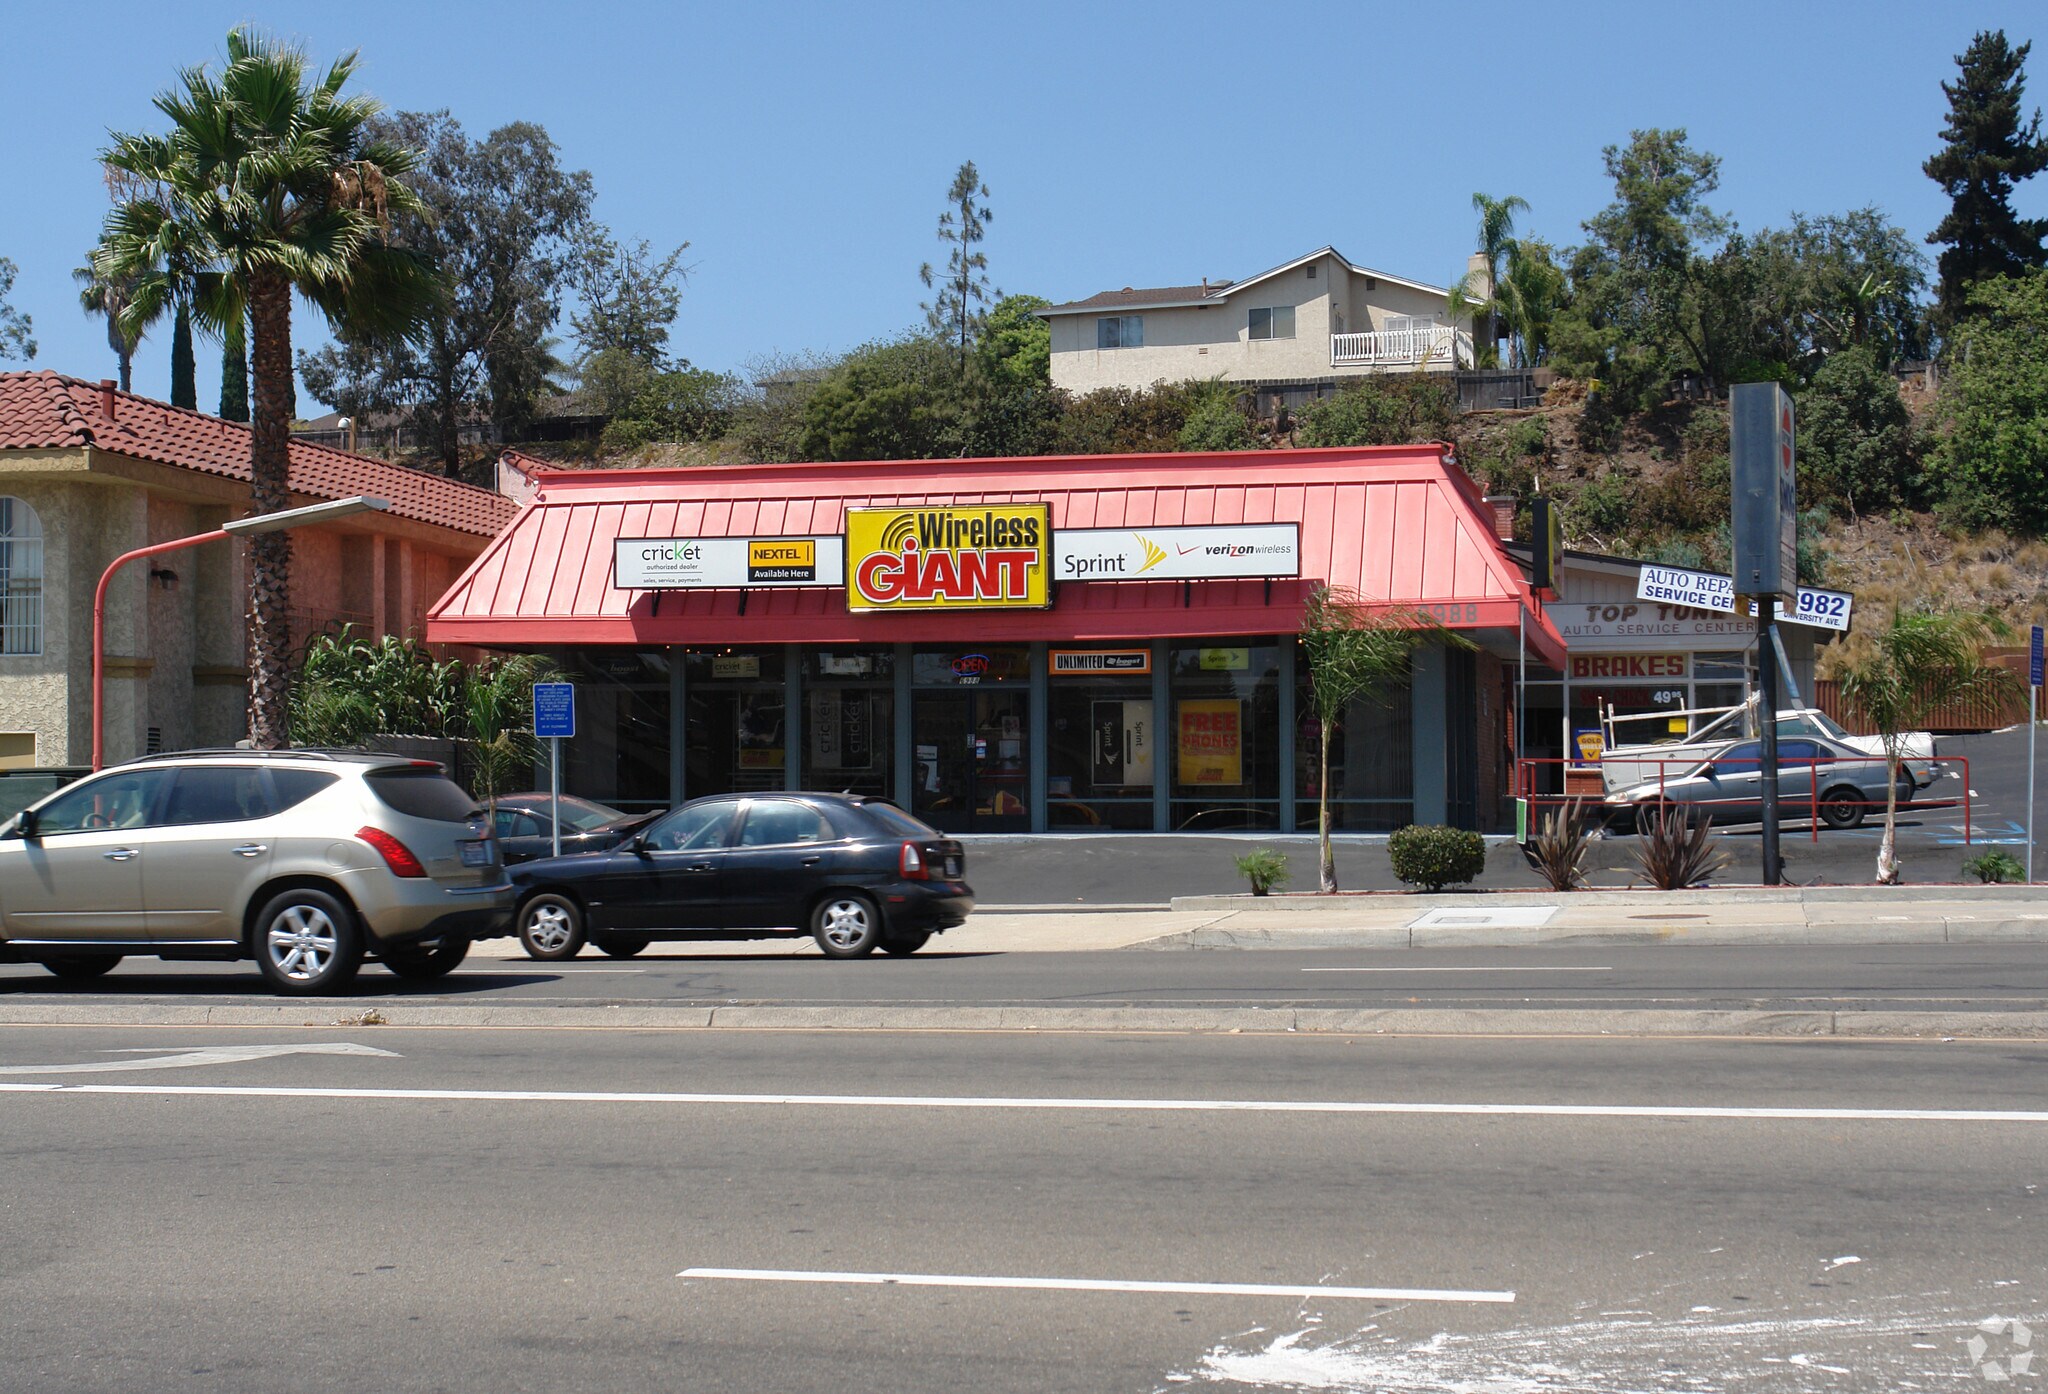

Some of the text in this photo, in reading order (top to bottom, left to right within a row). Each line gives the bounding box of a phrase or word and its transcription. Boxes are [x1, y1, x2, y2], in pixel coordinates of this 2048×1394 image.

[918, 511, 1038, 549] Wireless
[642, 541, 702, 561] cricket
[753, 548, 801, 560] NEXTEL
[646, 563, 678, 571] authorized
[754, 569, 809, 578] Available Here
[1065, 553, 1126, 577] Sprint
[658, 577, 677, 585] service,
[678, 577, 702, 585] payments
[1644, 568, 1689, 588] AUTO
[1645, 585, 1706, 605] SERVICE
[1797, 592, 1845, 618] 982
[1417, 603, 1478, 624] 6988
[1586, 605, 1639, 622] TOP
[1563, 621, 1754, 636] AUTO SERVICE CENTER
[715, 661, 740, 671] cricket
[952, 658, 989, 673] OPEN
[1057, 654, 1141, 669] UNLIMITED boost
[1573, 655, 1684, 678] BRAKES
[1182, 711, 1238, 731] FREE
[1102, 721, 1113, 747] Sprint
[1134, 721, 1144, 747] Sprint
[1182, 733, 1238, 748] PHONES
